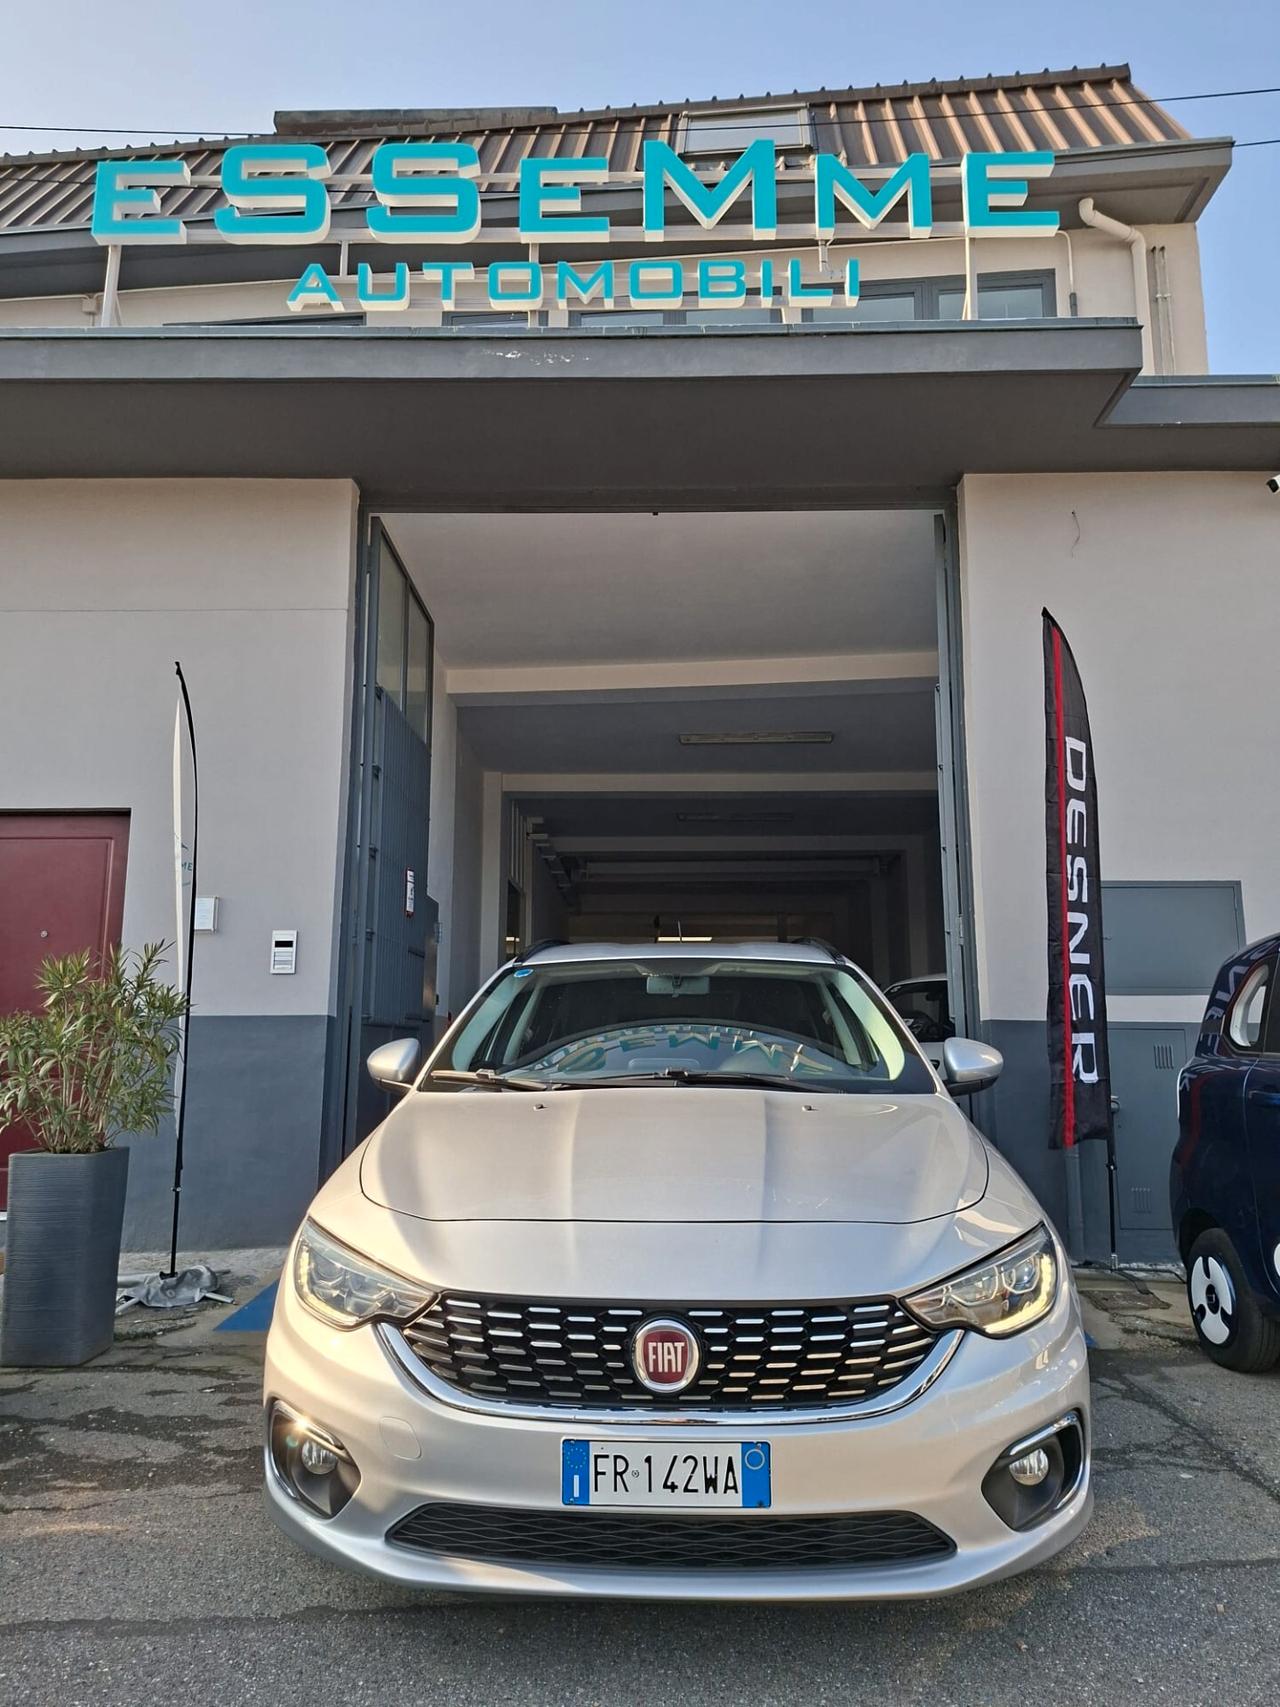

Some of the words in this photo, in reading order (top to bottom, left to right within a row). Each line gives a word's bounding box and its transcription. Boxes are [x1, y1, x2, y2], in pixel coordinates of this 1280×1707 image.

[90, 139, 1062, 245] ESSEMME
[287, 260, 862, 312] AUTOMOBILI
[1065, 736, 1099, 1084] DESNER
[647, 1341, 685, 1373] FIAT
